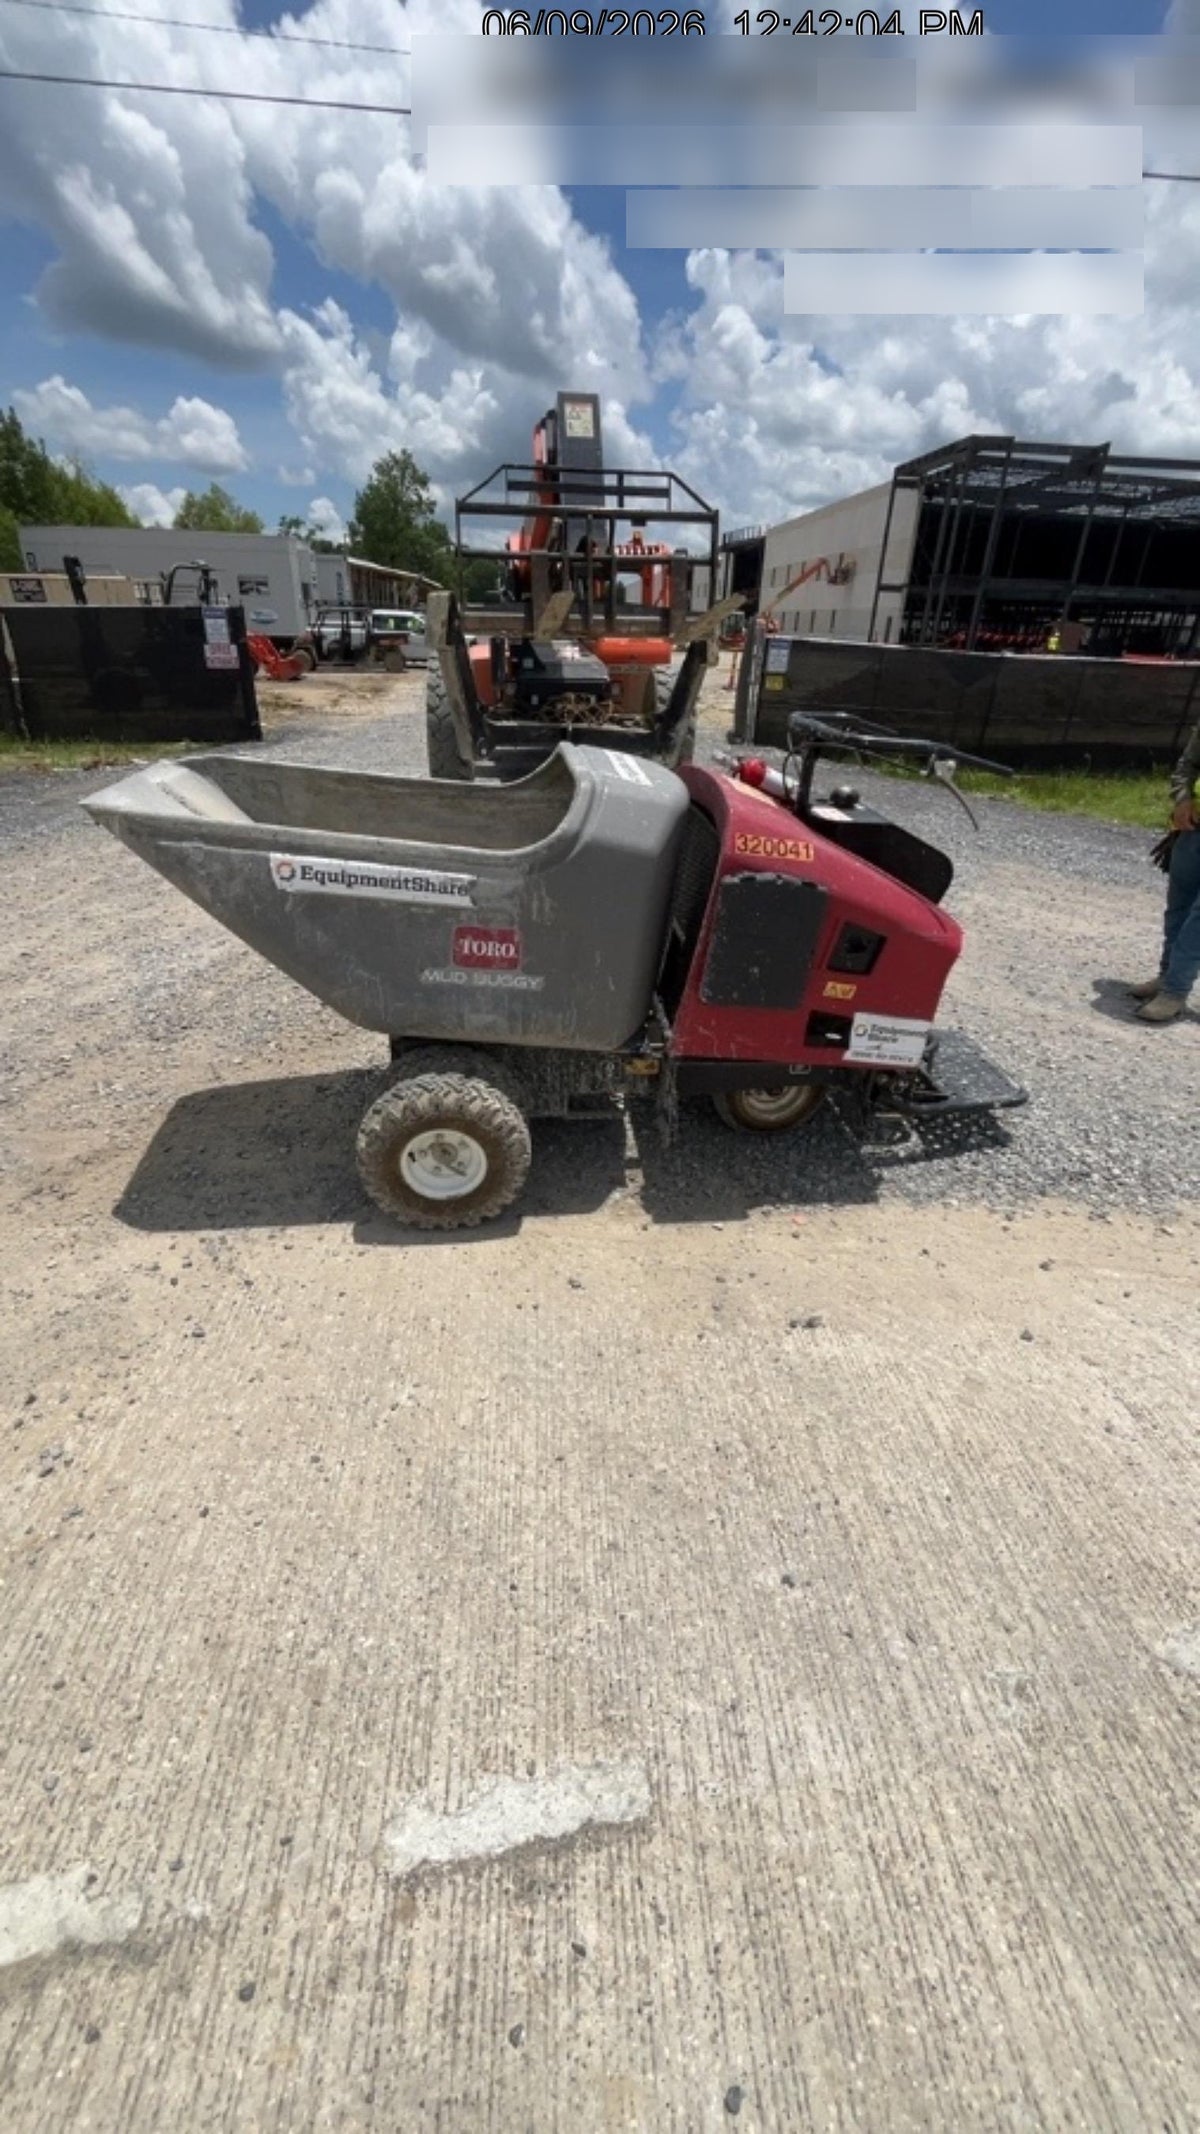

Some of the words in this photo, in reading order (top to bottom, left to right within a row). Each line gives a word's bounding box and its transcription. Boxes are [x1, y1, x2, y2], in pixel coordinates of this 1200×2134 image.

[737, 834, 811, 859] 320041
[301, 865, 470, 897] EquipmentShare
[461, 937, 515, 958] TORO
[421, 969, 467, 985] MUD
[473, 973, 544, 991] BUGGY
